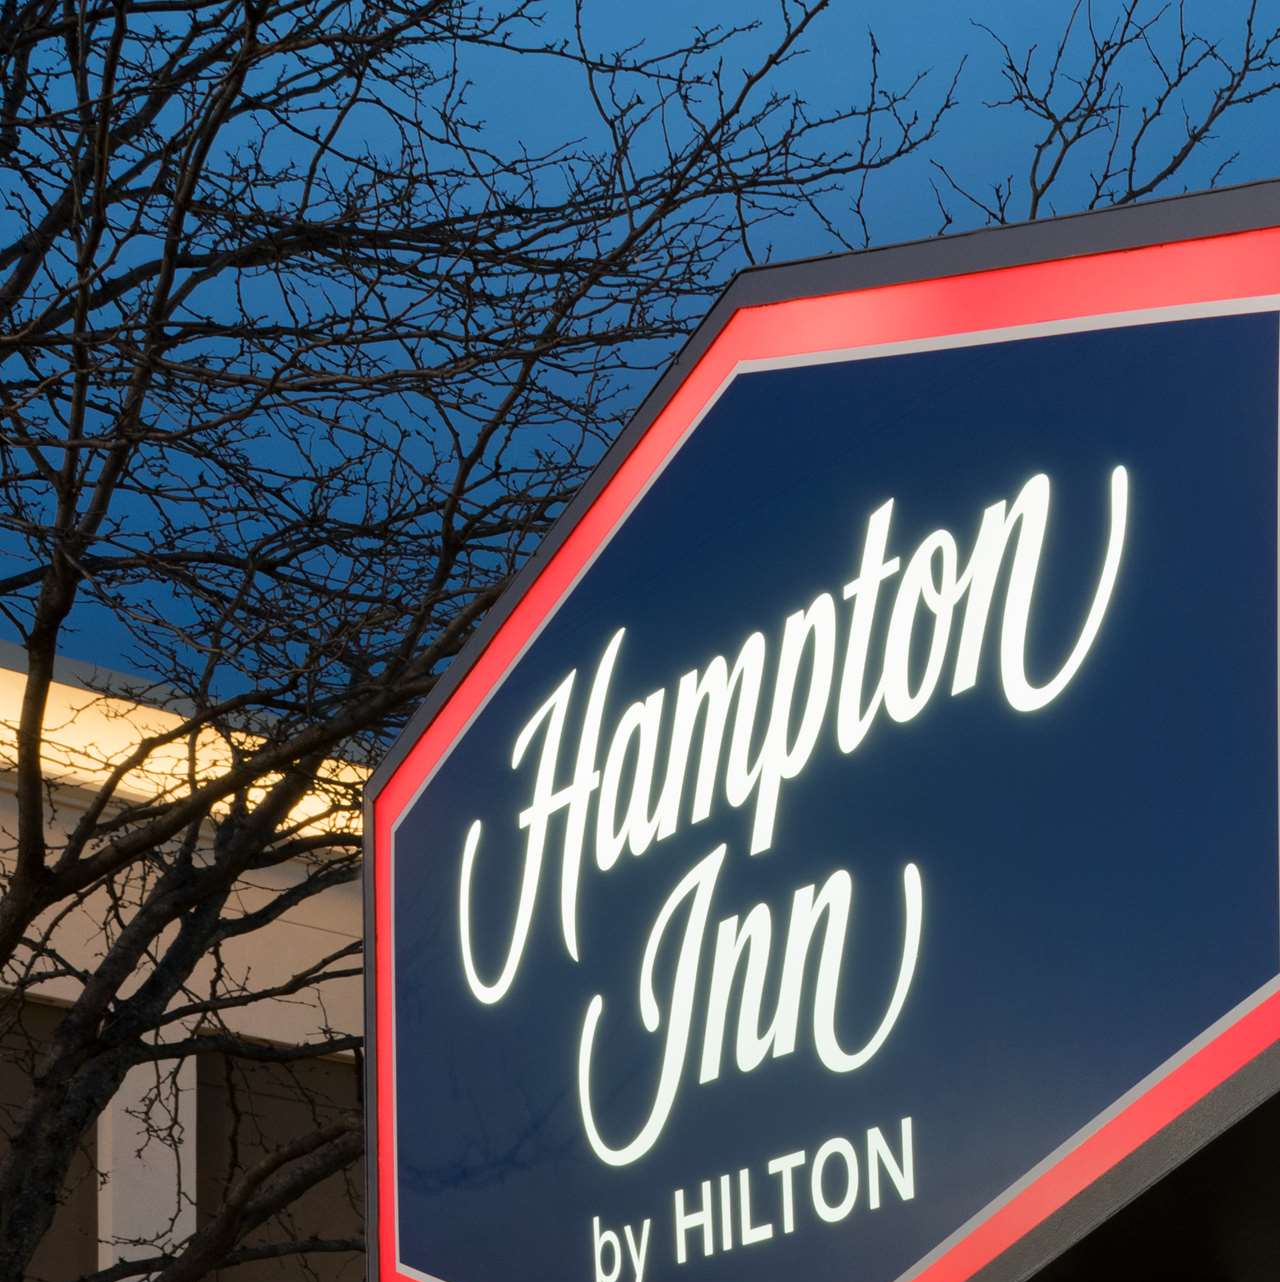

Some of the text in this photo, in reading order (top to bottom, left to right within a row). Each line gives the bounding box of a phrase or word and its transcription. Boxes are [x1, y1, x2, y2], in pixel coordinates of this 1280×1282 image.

[459, 465, 1129, 1005] Hampton
[578, 842, 923, 1167] Inn
[674, 1116, 915, 1264] HILTON
